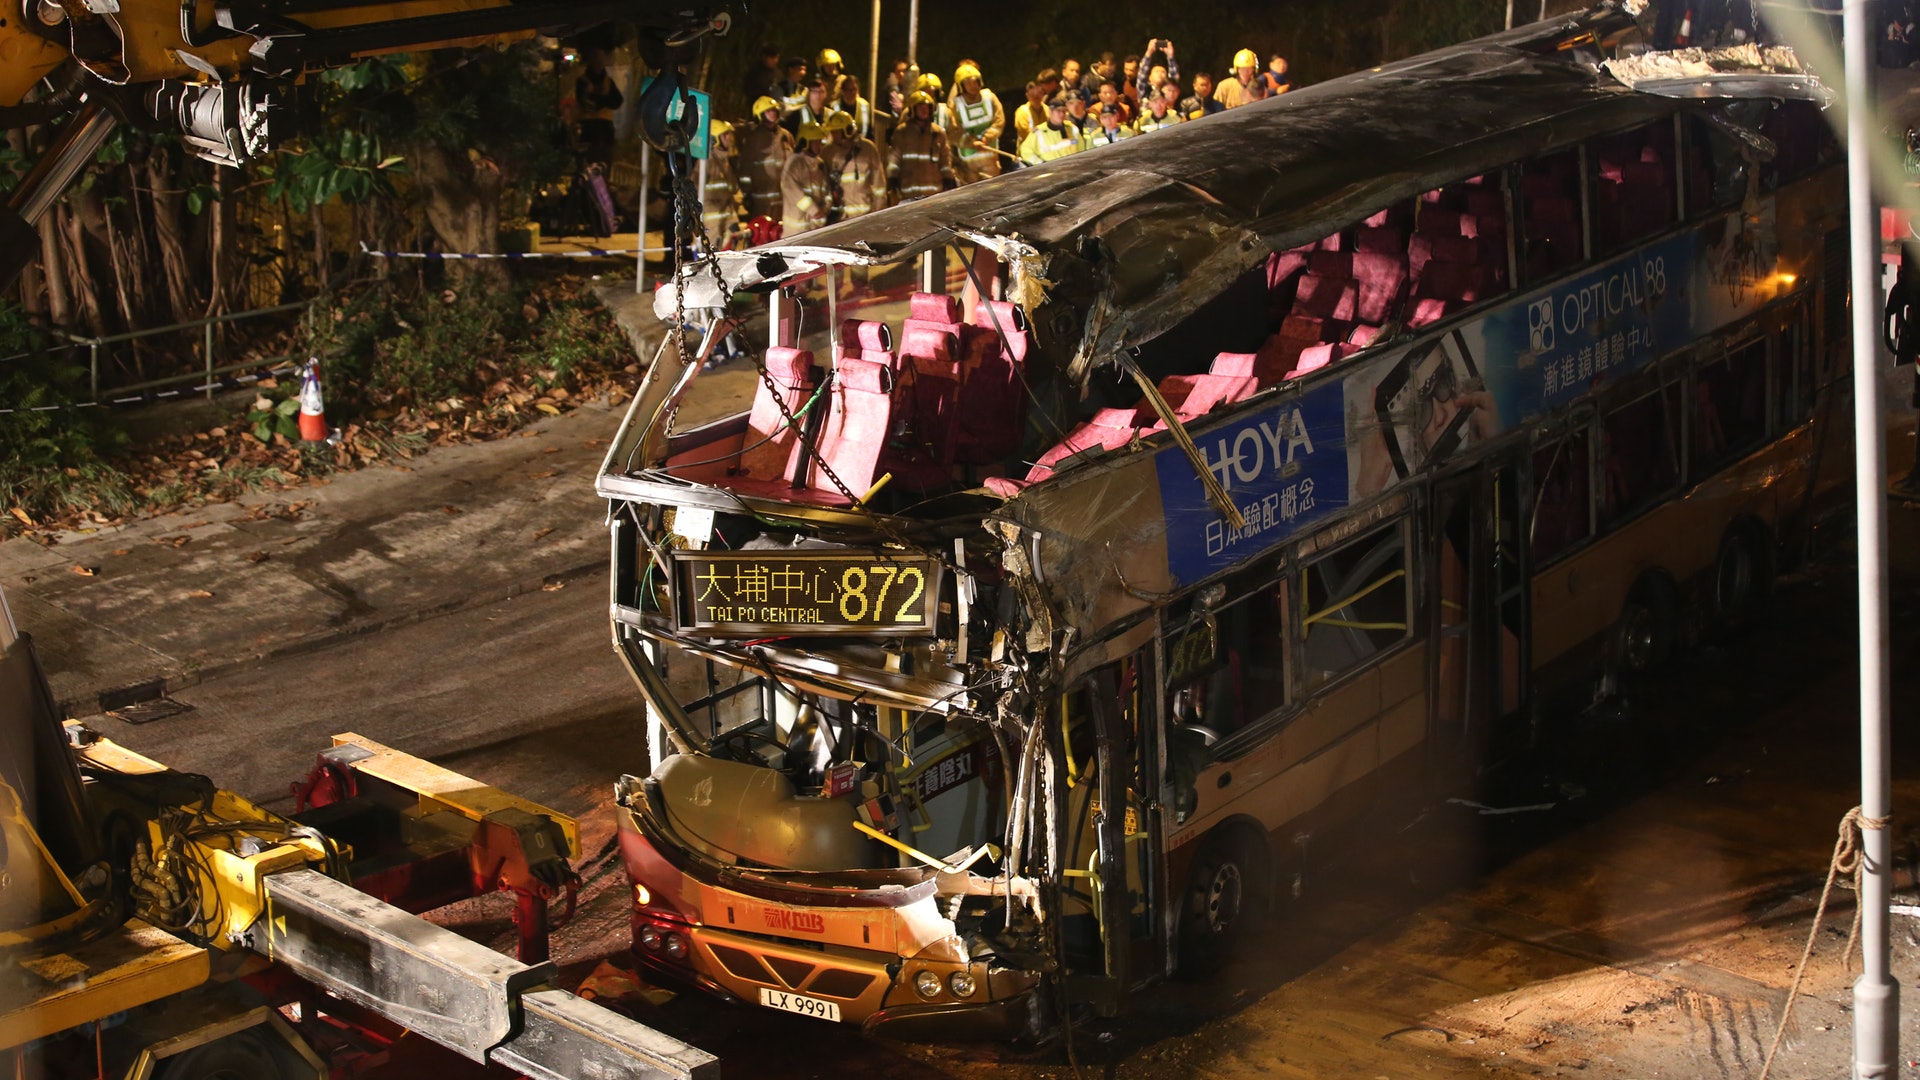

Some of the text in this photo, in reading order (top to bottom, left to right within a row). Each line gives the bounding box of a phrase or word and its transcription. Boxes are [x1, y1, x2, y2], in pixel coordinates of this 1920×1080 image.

[1562, 256, 1667, 335] OPTICAL 88
[1543, 324, 1655, 398] 漸進鏡體驗中心
[1194, 407, 1315, 501] HOYA
[696, 564, 841, 605] 大埔中心
[839, 566, 925, 622] 872
[707, 606, 825, 623] TAI PO CENTRAL
[768, 991, 833, 1019] LX 9991
